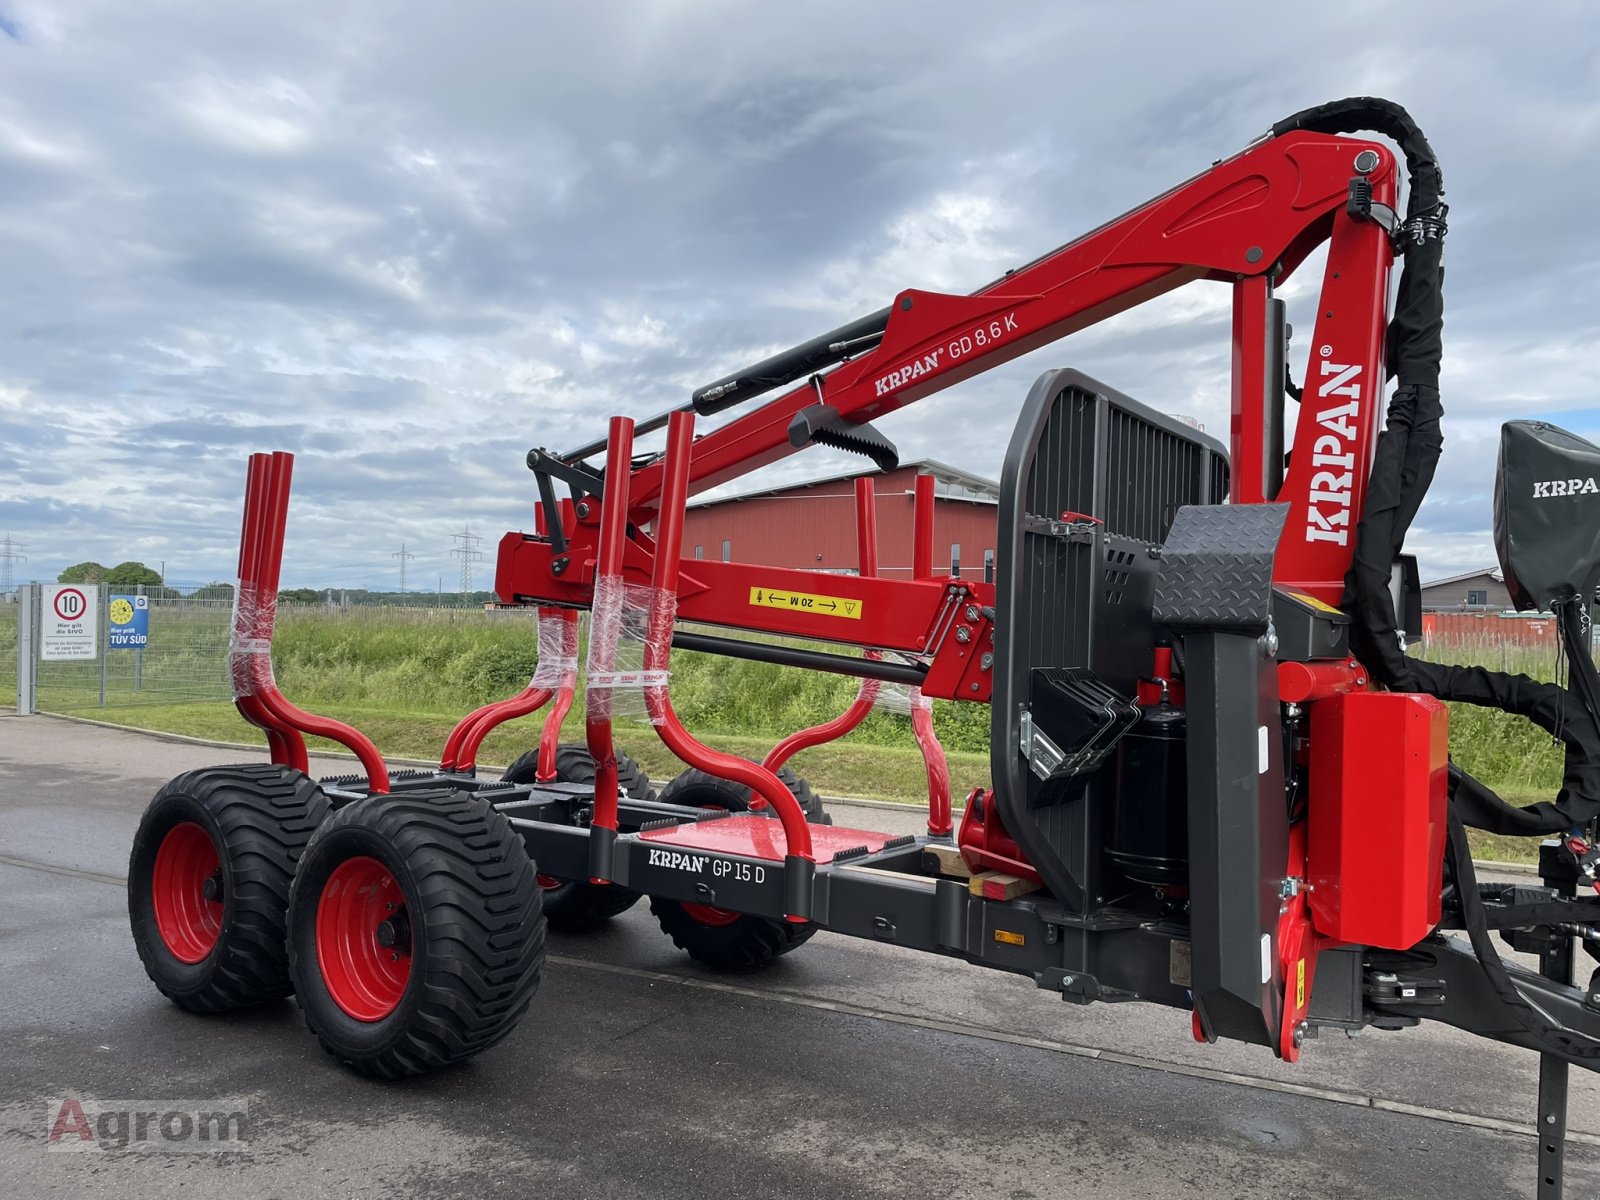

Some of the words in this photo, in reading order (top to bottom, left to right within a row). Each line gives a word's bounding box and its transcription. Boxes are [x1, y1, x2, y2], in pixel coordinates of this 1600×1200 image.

[949, 336, 972, 359] GD
[975, 321, 1002, 347] 8,6
[1004, 312, 1019, 332] K
[1533, 478, 1600, 498] KRPA
[63, 596, 77, 613] 10
[790, 596, 799, 605] M
[801, 598, 813, 608] 20
[111, 633, 128, 644] TÜV
[130, 633, 147, 644] SÜD
[713, 860, 731, 877] GP
[735, 863, 751, 881] 15
[755, 867, 765, 883] D
